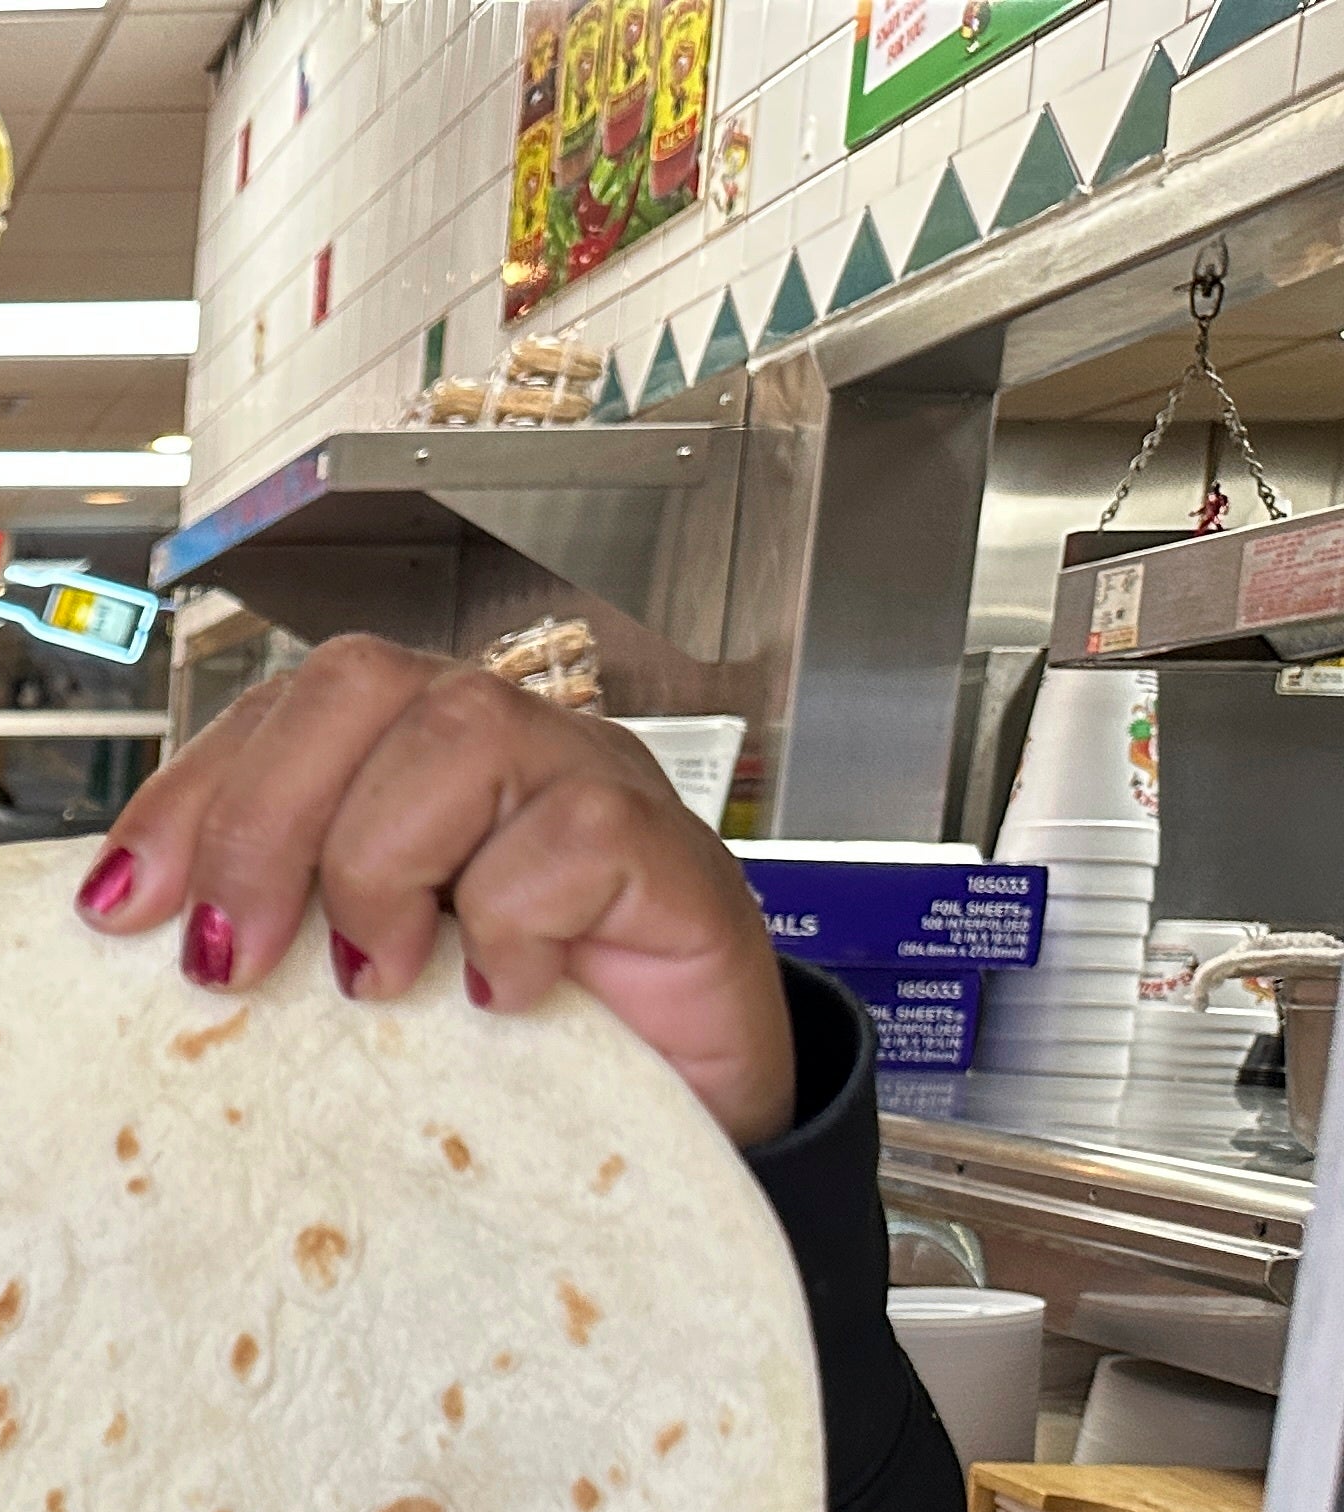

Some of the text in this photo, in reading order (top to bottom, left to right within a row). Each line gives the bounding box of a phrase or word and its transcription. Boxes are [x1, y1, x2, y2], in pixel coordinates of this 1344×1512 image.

[931, 900, 1021, 917] FOIL SHEETS
[762, 913, 819, 936] IALS
[895, 1005, 954, 1022] SHEETS
[876, 1022, 964, 1037] NTERFOLDED
